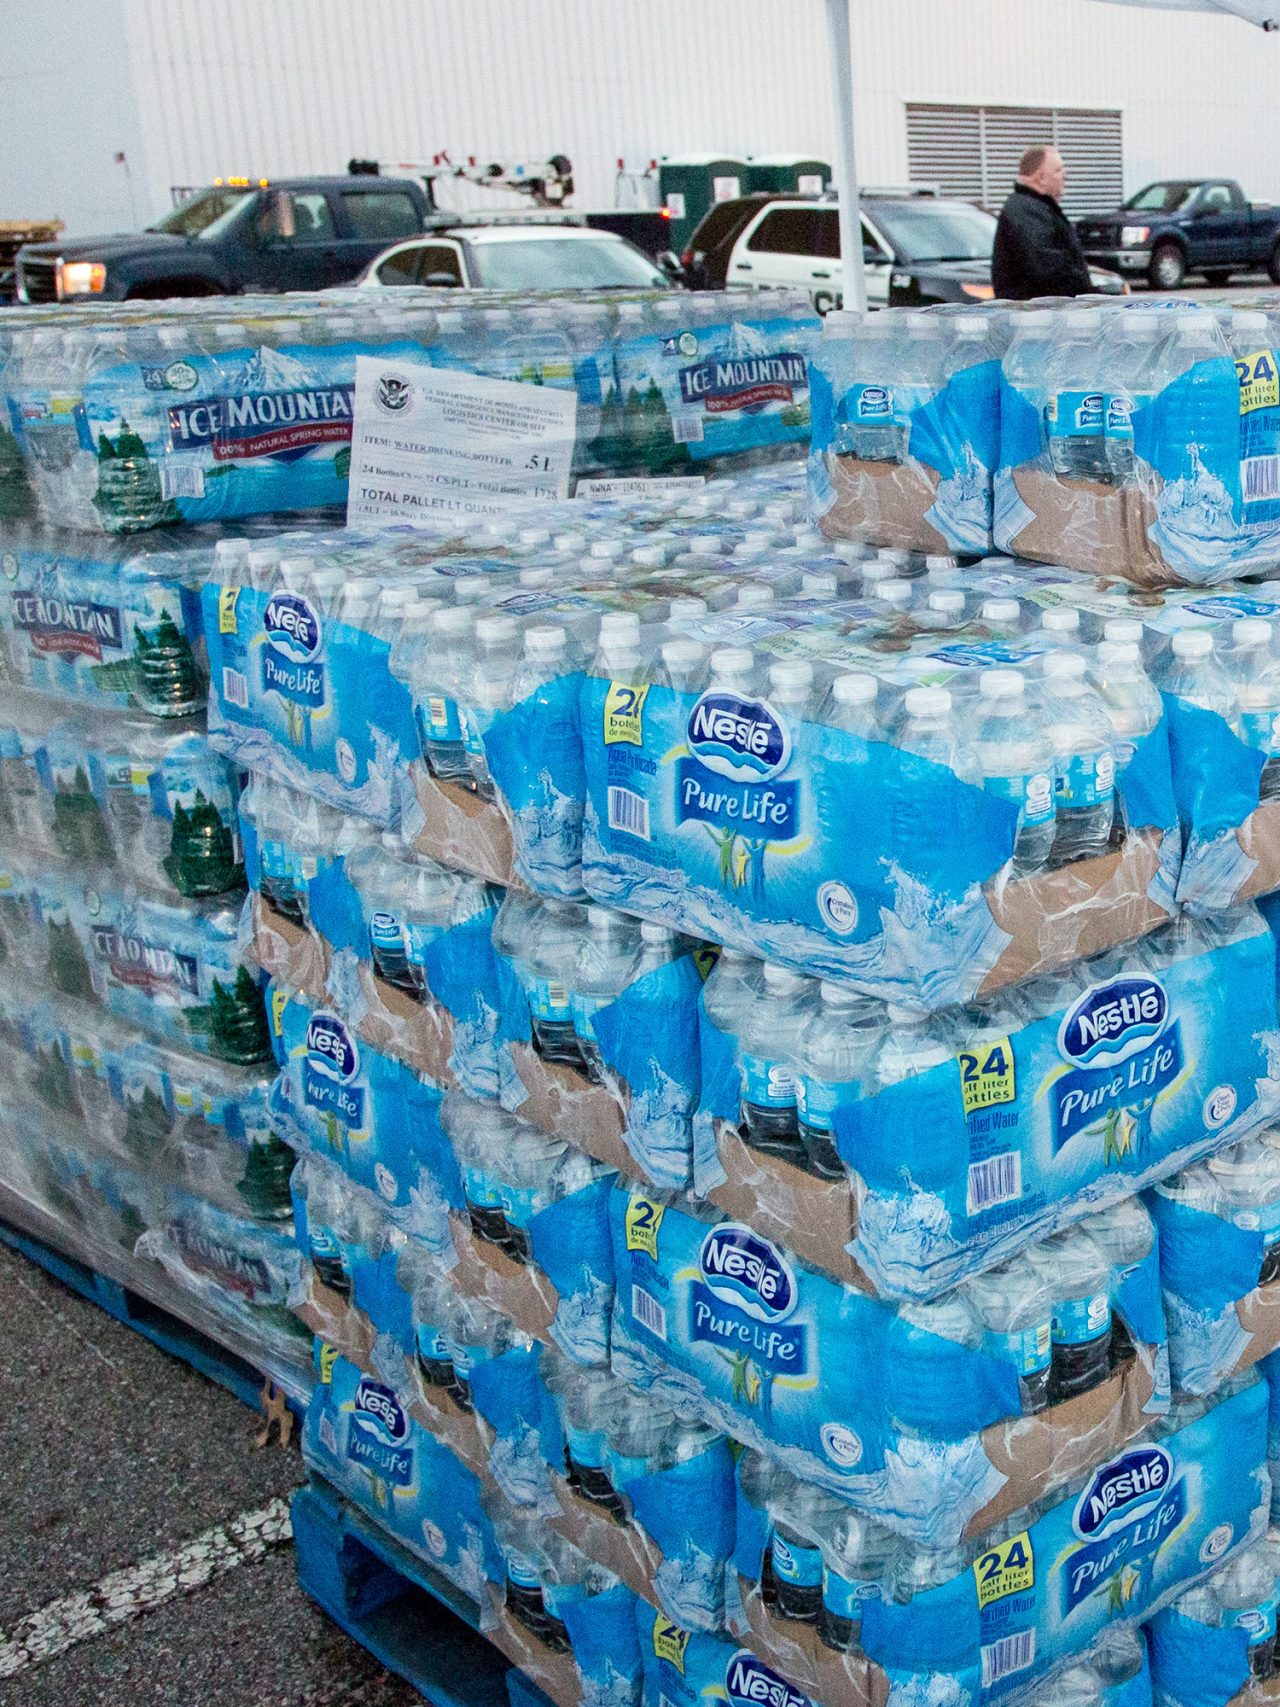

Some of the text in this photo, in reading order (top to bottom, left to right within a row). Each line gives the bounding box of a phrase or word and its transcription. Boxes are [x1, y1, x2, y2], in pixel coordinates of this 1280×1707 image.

[685, 359, 805, 396] ICE MOUNTAIN
[1241, 394, 1276, 407] ottles
[178, 406, 222, 440] ICE
[251, 436, 288, 451] NATURAL
[289, 429, 321, 442] SPRING
[364, 435, 391, 447] ITEM:
[363, 464, 374, 473] 24
[361, 488, 399, 503] TOTAL
[402, 494, 446, 509] PALLET
[265, 658, 321, 695] Pure Life
[682, 777, 790, 825] Pure Life
[1078, 986, 1159, 1045] Nestlé
[960, 1047, 1009, 1082] 24
[966, 1090, 1010, 1105] ottles
[983, 1079, 1009, 1090] liter
[1060, 1044, 1175, 1128] Pure Life
[992, 1111, 1019, 1130] Water
[695, 1301, 797, 1360] Pure Life
[380, 1452, 409, 1475] Life
[1089, 1455, 1164, 1524] Nestlé
[1072, 1539, 1130, 1594] Pure
[1132, 1502, 1177, 1549] Life
[978, 1541, 1029, 1584] 24
[1005, 1569, 1028, 1581] liter
[1012, 1595, 1036, 1613] Water
